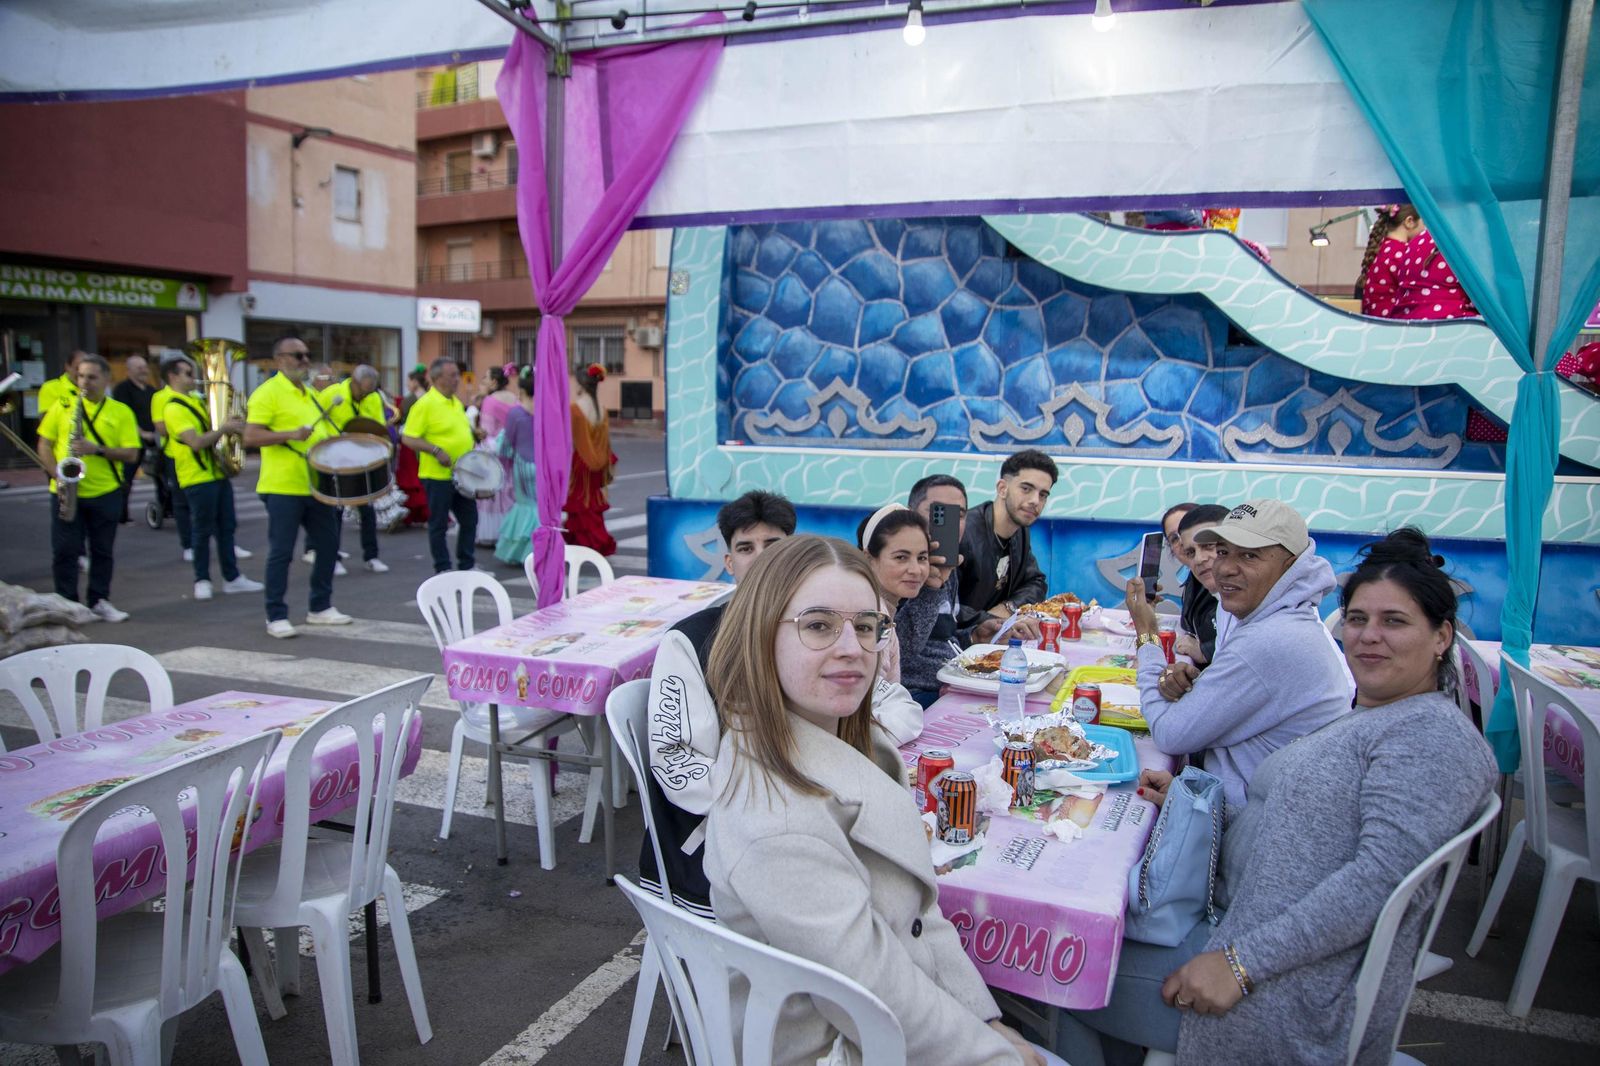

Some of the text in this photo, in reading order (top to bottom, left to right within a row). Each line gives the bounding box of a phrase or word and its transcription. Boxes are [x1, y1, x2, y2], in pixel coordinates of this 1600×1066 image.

[0, 282, 156, 307] FARMAVISION
[87, 273, 165, 293] OPTICO
[447, 664, 509, 693] COMO
[536, 671, 597, 704] COMO
[950, 910, 1086, 984] COMO
